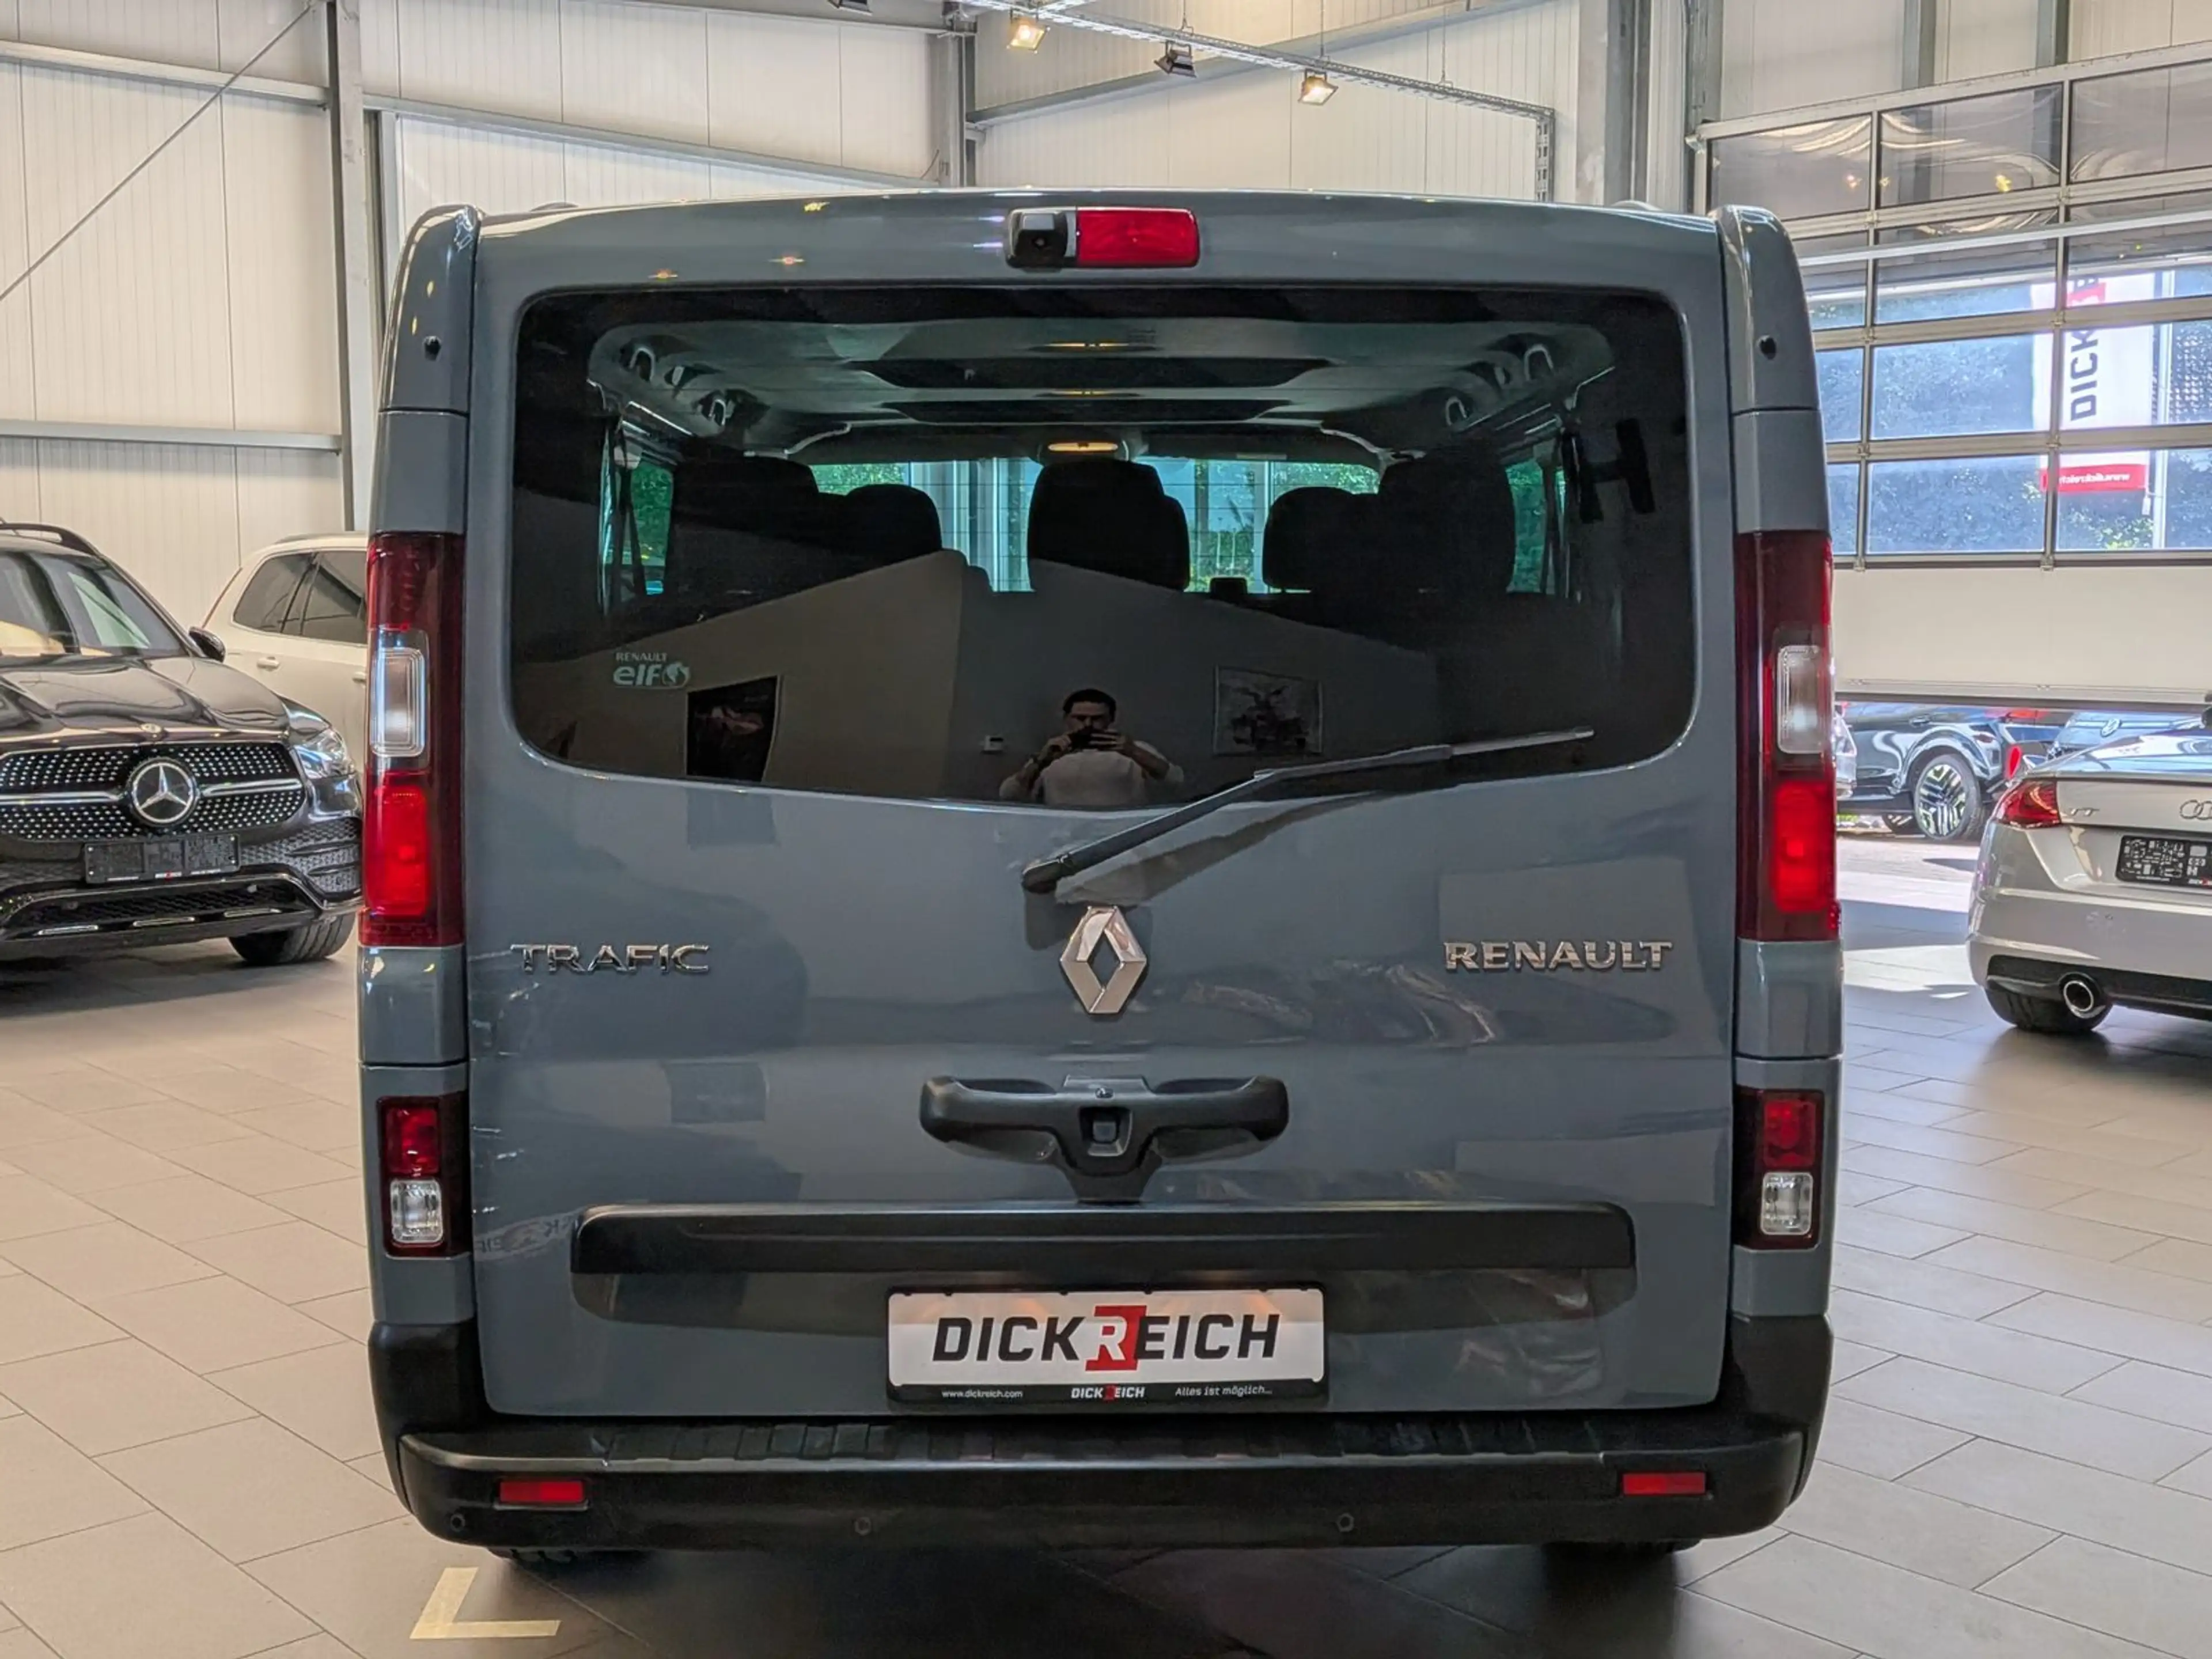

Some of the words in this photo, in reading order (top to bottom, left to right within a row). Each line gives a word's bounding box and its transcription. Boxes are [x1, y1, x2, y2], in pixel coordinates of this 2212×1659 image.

[615, 652, 668, 662] RENAULT
[613, 664, 661, 686] elf
[510, 944, 710, 973] TRAFIC
[1443, 940, 1673, 970] RENAULT
[932, 1305, 1281, 1371] DICKREICH
[942, 1388, 1023, 1399] www.dickreich.com
[1175, 1387, 1202, 1396] Alles
[1204, 1385, 1220, 1396] ist
